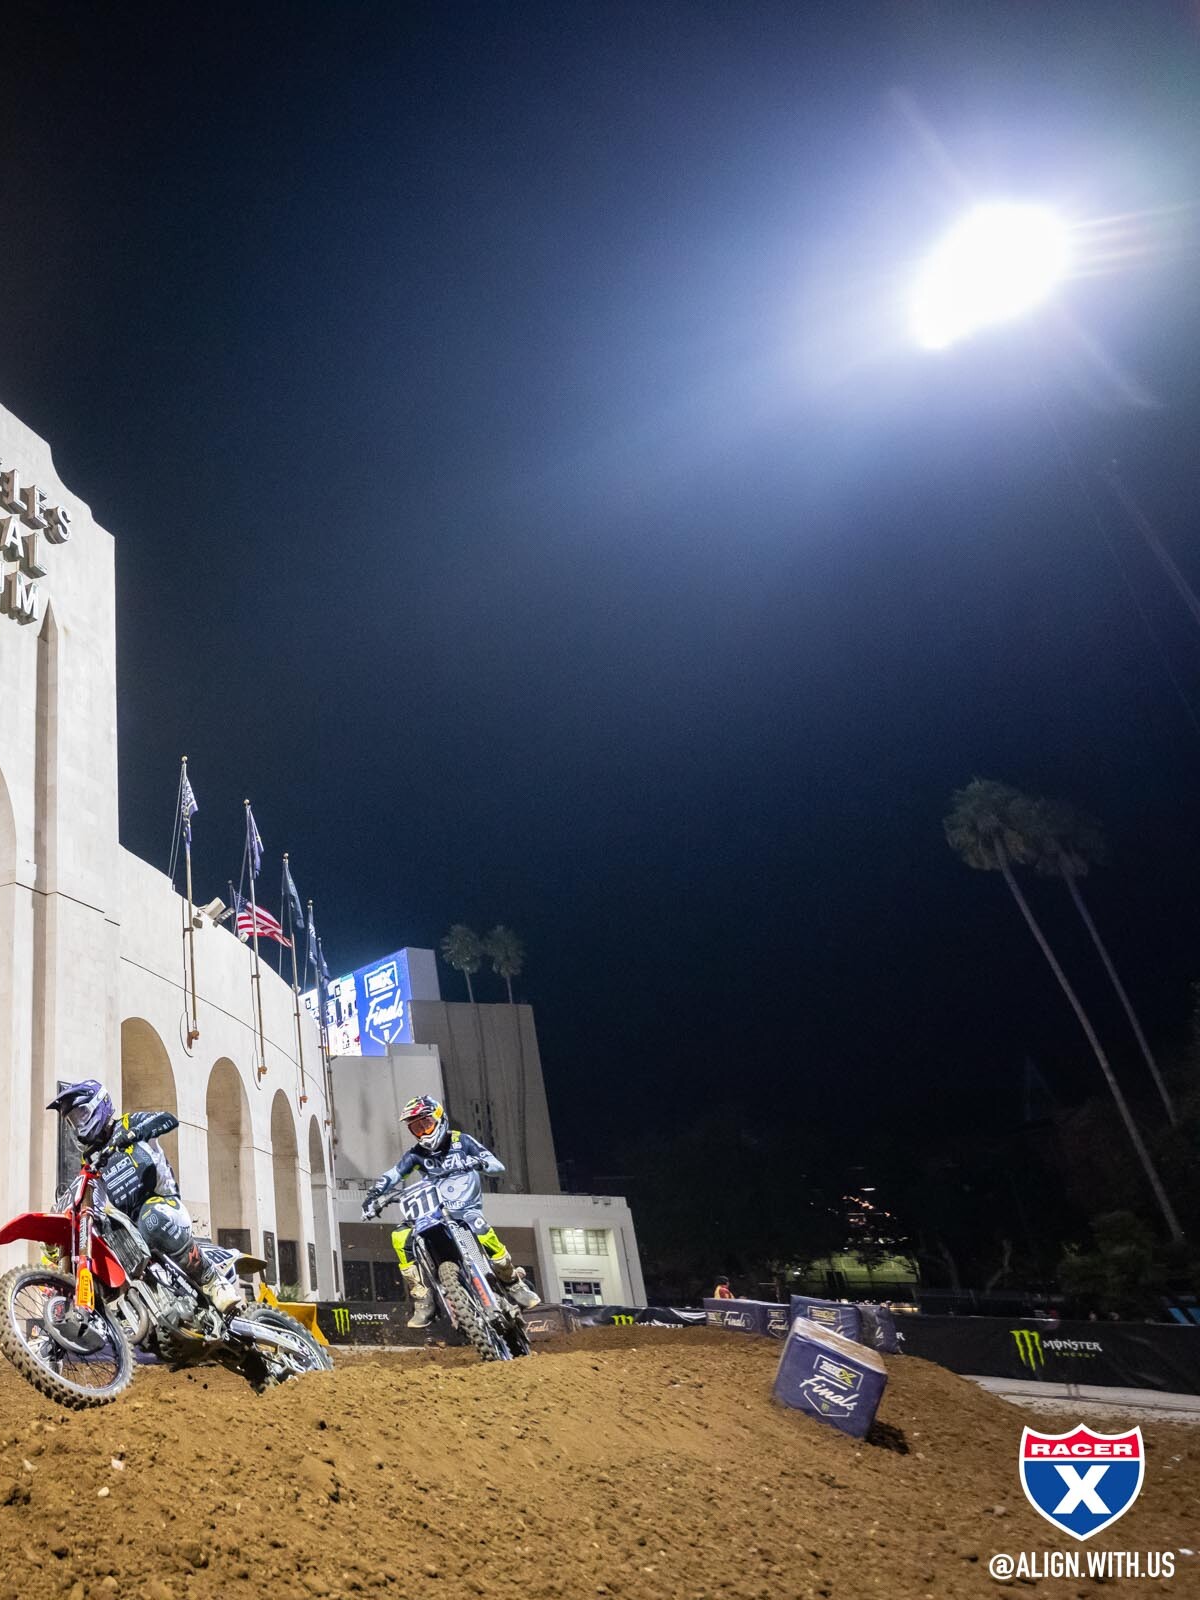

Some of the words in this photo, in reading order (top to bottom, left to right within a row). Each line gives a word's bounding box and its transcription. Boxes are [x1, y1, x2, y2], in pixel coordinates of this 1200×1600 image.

[365, 989, 404, 1033] Finals
[401, 1187, 441, 1220] 511
[80, 1275, 90, 1304] PIRELLI
[351, 1313, 389, 1321] MONSTER
[525, 1320, 549, 1334] Finals
[724, 1311, 746, 1327] Finals
[1043, 1339, 1103, 1352] MONSTER
[800, 1374, 861, 1411] Finals
